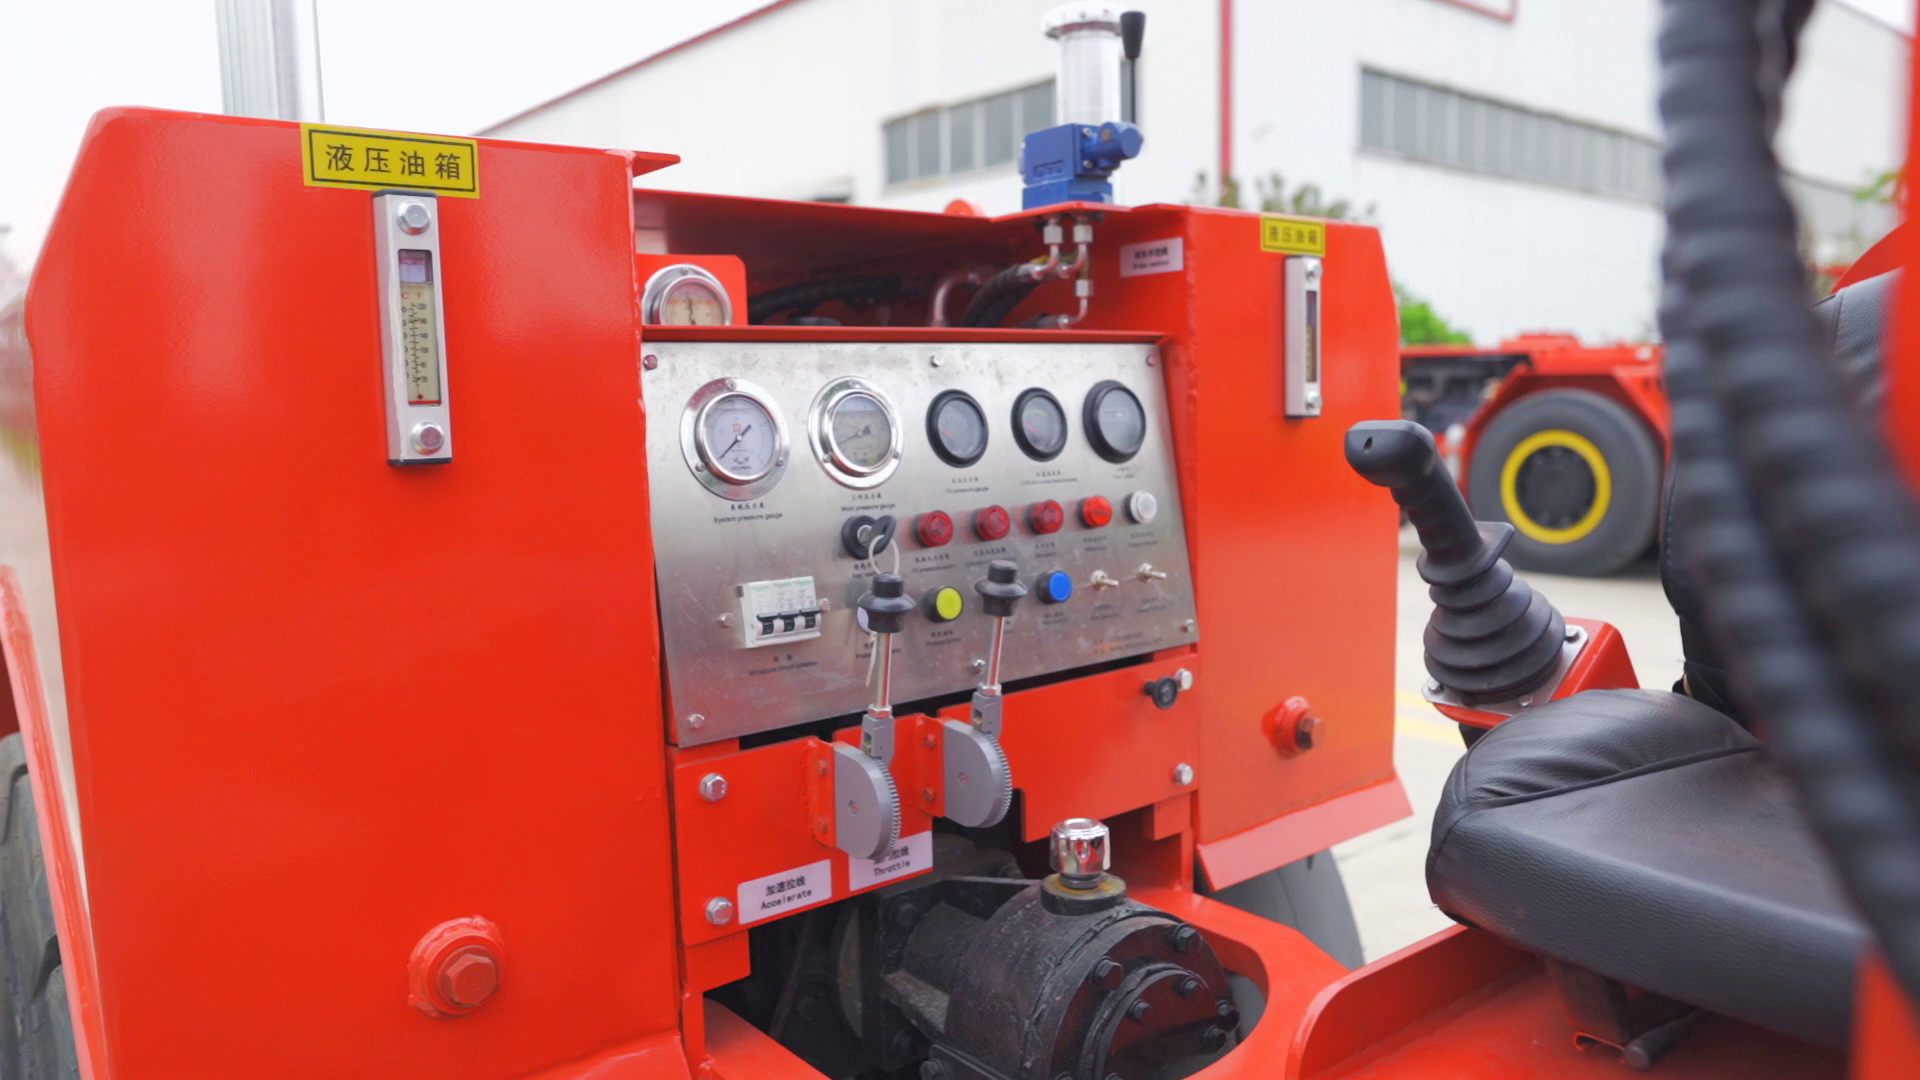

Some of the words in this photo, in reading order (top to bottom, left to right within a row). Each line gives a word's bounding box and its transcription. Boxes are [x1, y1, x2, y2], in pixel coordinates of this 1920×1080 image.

[325, 144, 461, 180] 液压油箱
[873, 860, 910, 876] Throttle
[766, 875, 806, 896] 加速拉线
[760, 889, 812, 911] Accelerate
